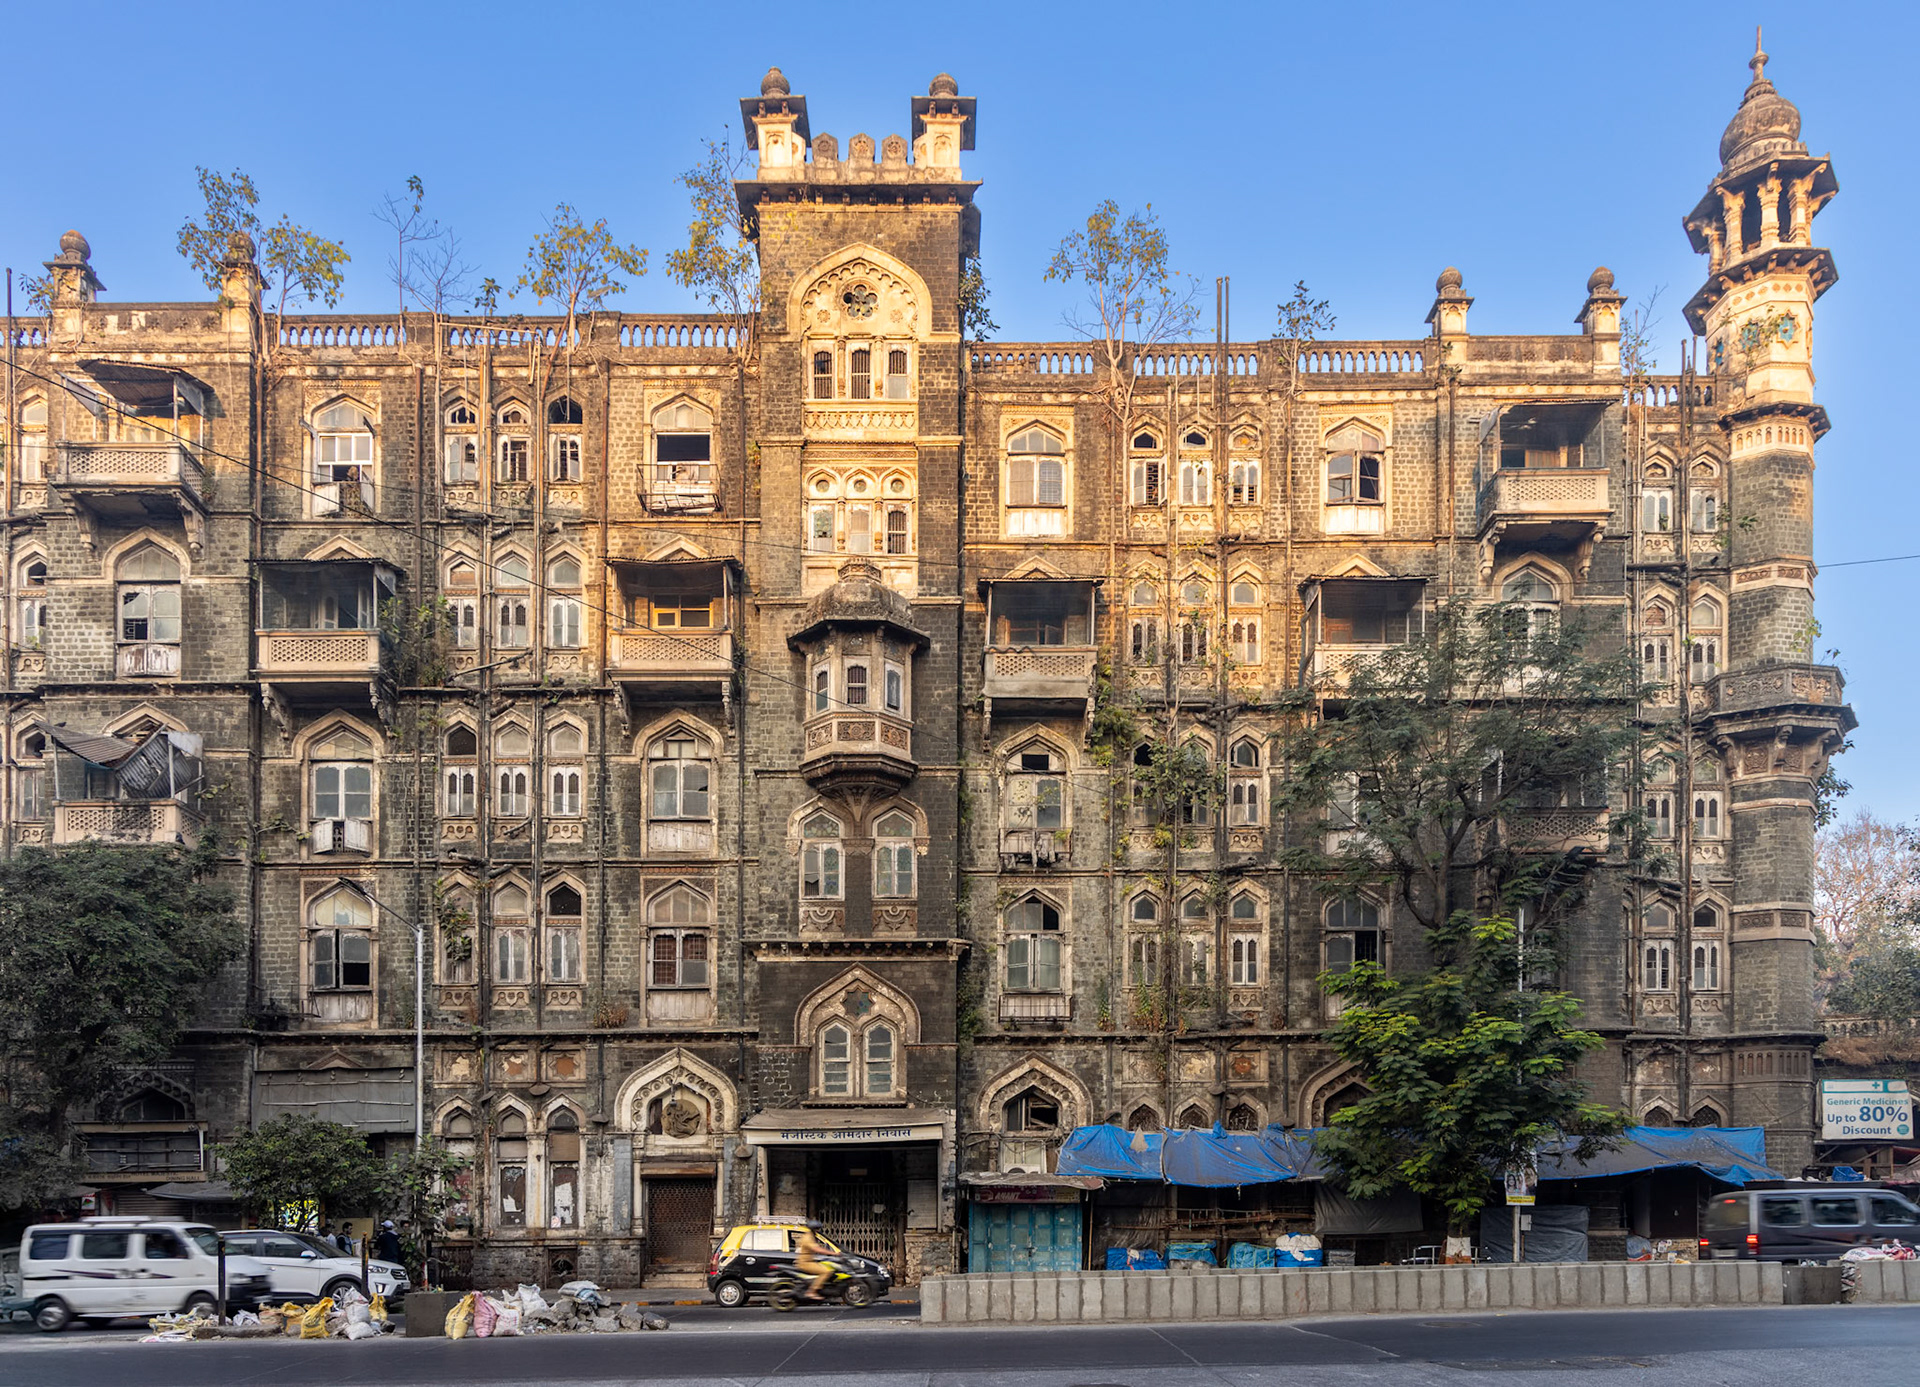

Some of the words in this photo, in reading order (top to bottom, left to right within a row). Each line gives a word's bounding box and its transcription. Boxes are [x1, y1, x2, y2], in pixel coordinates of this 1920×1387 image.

[1827, 1113, 1842, 1124] Up
[1844, 1114, 1856, 1122] to
[1859, 1106, 1909, 1122] 80%
[1842, 1125, 1892, 1135] Discount
